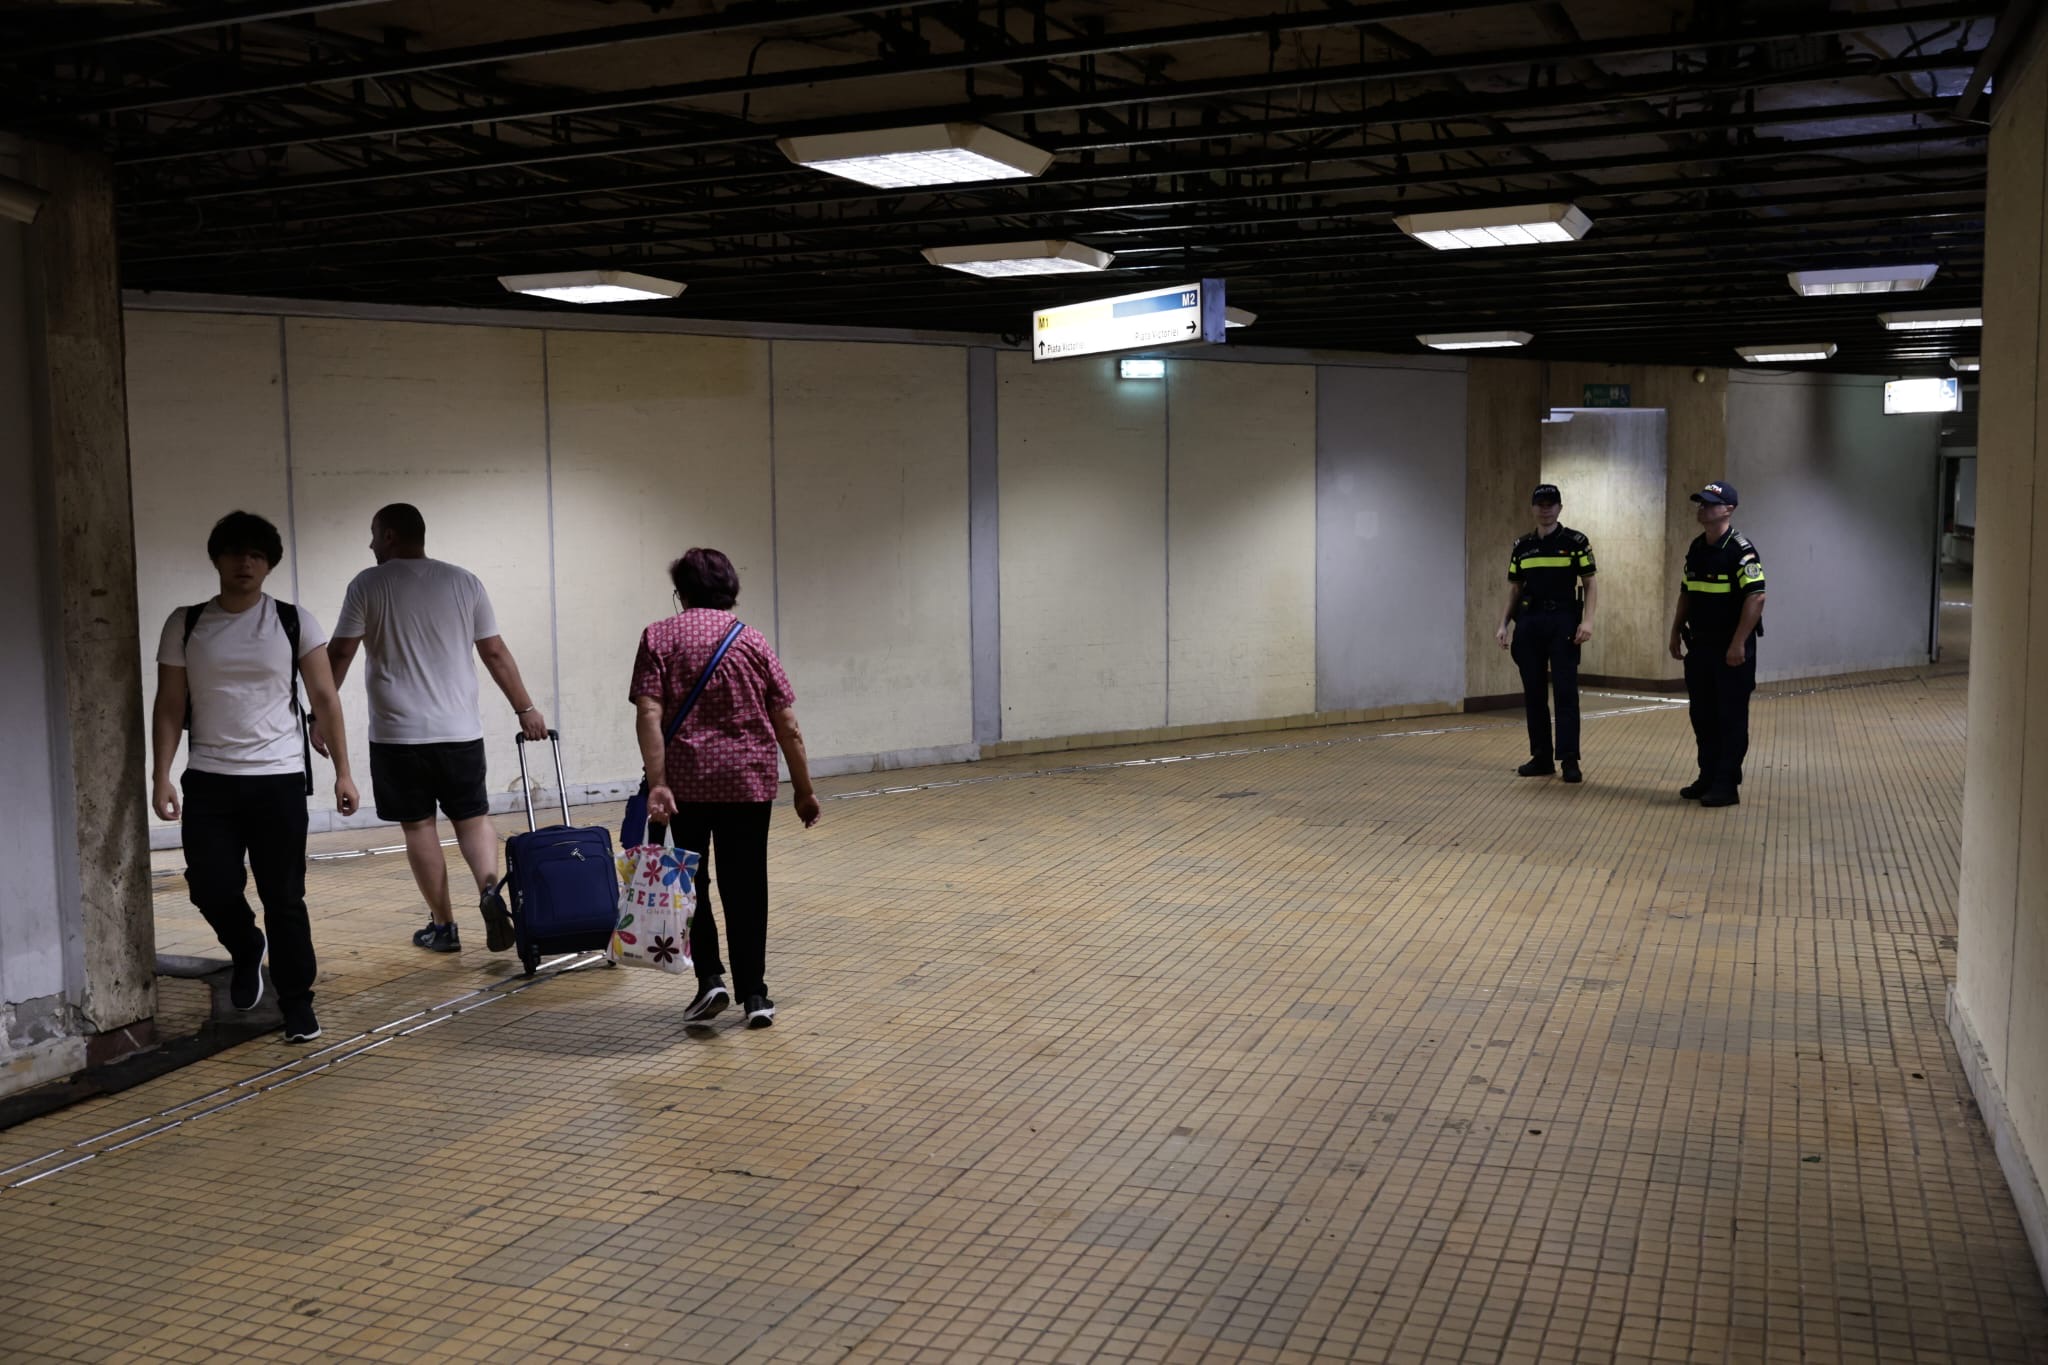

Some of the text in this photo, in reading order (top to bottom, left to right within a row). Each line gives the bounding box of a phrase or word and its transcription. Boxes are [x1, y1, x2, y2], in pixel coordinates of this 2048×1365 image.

[1182, 293, 1196, 307] M2
[1038, 317, 1049, 330] M1
[1062, 341, 1086, 352] Victorie
[626, 888, 683, 909] REEZE
